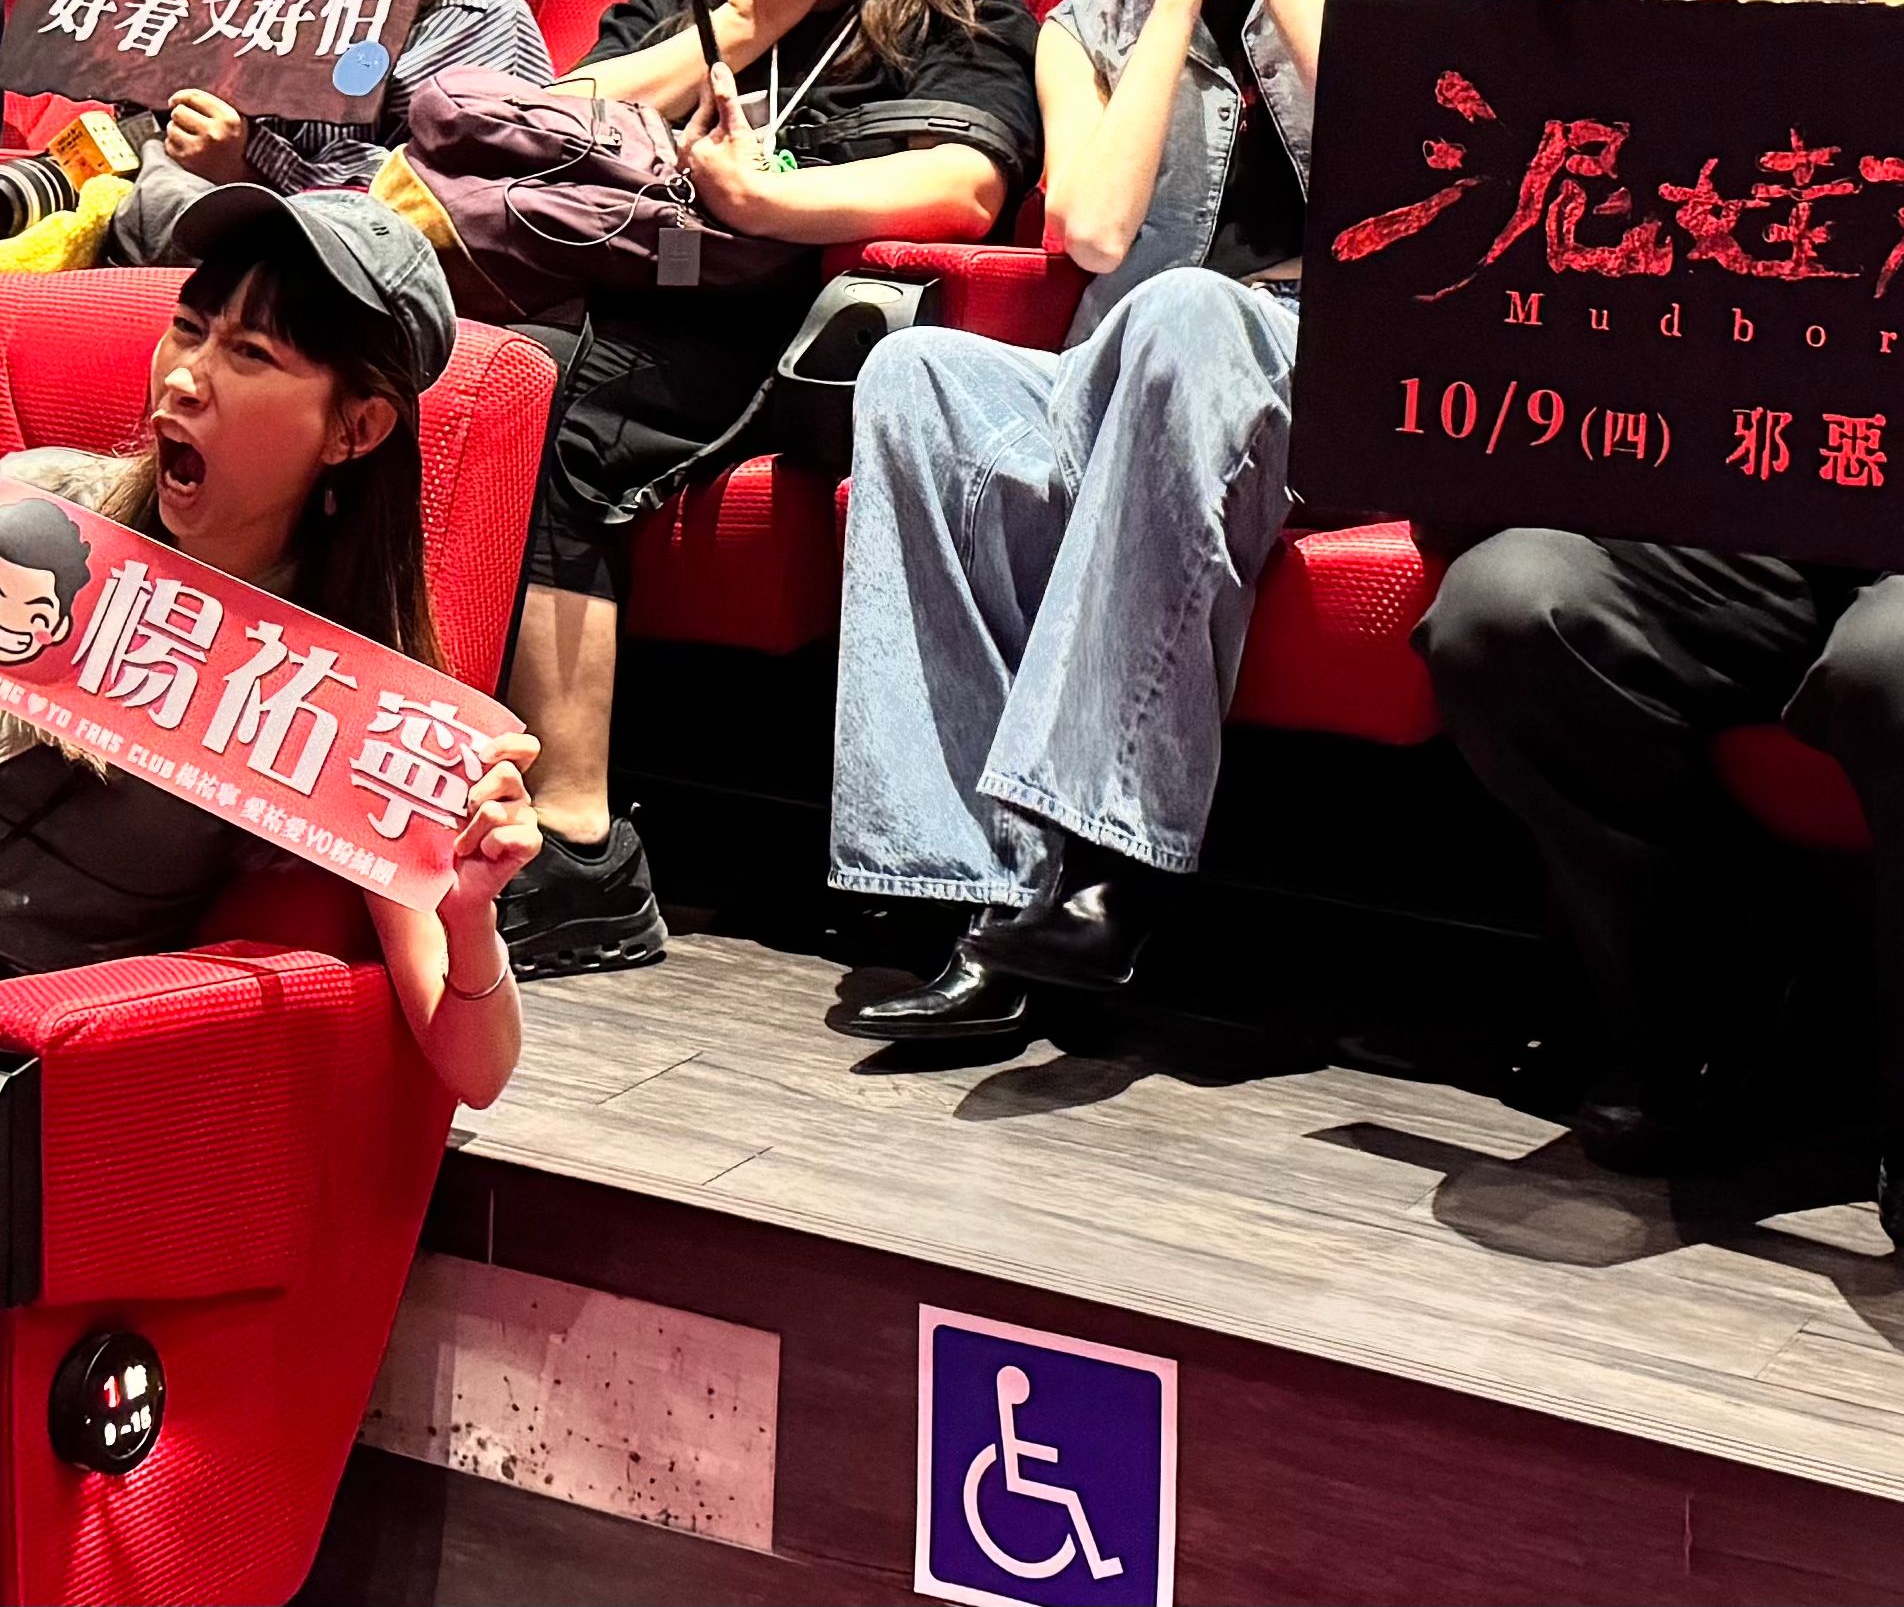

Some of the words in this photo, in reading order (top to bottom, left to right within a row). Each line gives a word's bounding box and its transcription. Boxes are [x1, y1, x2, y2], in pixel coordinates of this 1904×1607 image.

[70, 559, 492, 839] 楊祐寧
[74, 717, 125, 754] FANS
[127, 744, 177, 780] CLUB
